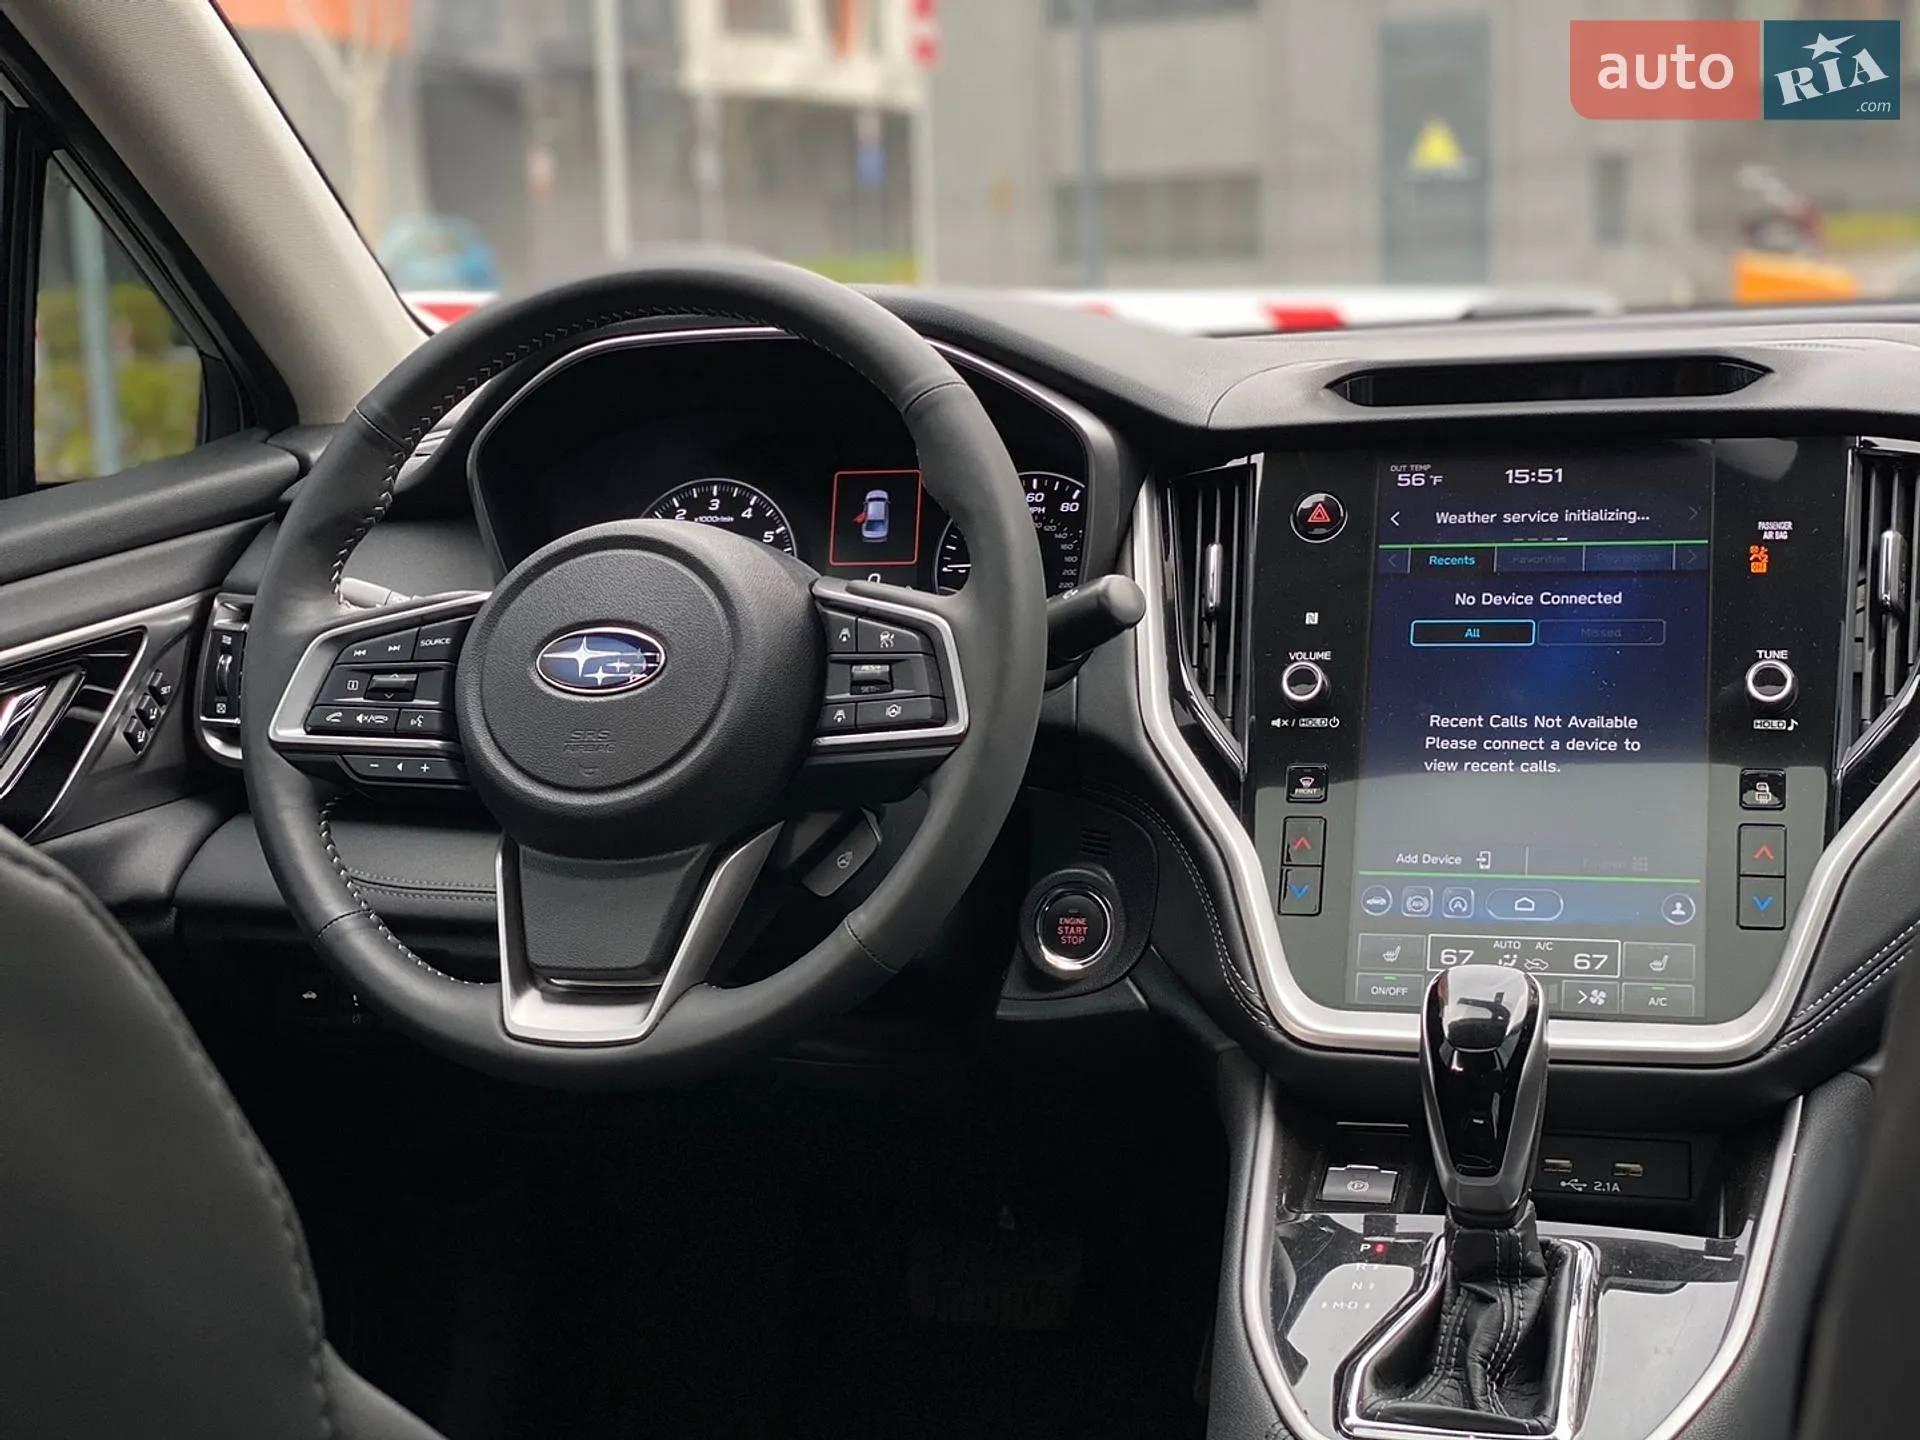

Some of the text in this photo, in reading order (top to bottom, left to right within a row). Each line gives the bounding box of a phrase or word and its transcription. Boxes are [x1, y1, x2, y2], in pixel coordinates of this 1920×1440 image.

[1390, 464, 1432, 472] OUT TEMP
[1397, 473, 1425, 487] 56
[1505, 468, 1563, 484] 15:51
[1026, 492, 1045, 503] 60
[708, 498, 720, 511] 3
[1060, 502, 1080, 512] 80
[675, 508, 687, 520] 2
[741, 507, 753, 519] 4
[1436, 508, 1650, 524] Weather service initializing...
[762, 531, 774, 543] 5
[1429, 554, 1476, 566] Recents
[1455, 591, 1623, 605] No Device Connected
[1464, 628, 1481, 638] All
[420, 636, 452, 647] SOURCE
[1288, 650, 1332, 660] VOLUME
[1756, 649, 1789, 660] TUNE
[1429, 714, 1638, 729] Recent Calls Not Available
[1753, 719, 1786, 729] HOLD
[570, 729, 610, 741] SRS
[1425, 736, 1641, 751] Please connect a device to
[1424, 759, 1561, 773] view recent calls.
[1294, 788, 1317, 796] FRONT
[1396, 853, 1462, 865] Add Device
[1058, 917, 1087, 925] ENGINE
[1057, 926, 1088, 935] START
[1060, 935, 1086, 945] STOP
[1493, 940, 1553, 951] AUTO A/C
[1440, 948, 1474, 965] 67
[1573, 953, 1609, 970] 67
[1370, 986, 1408, 996] ON/OFF
[1648, 997, 1668, 1006] A/C
[1593, 1181, 1621, 1193] 2.1A
[1360, 1243, 1371, 1252] P
[1352, 1281, 1363, 1290] N
